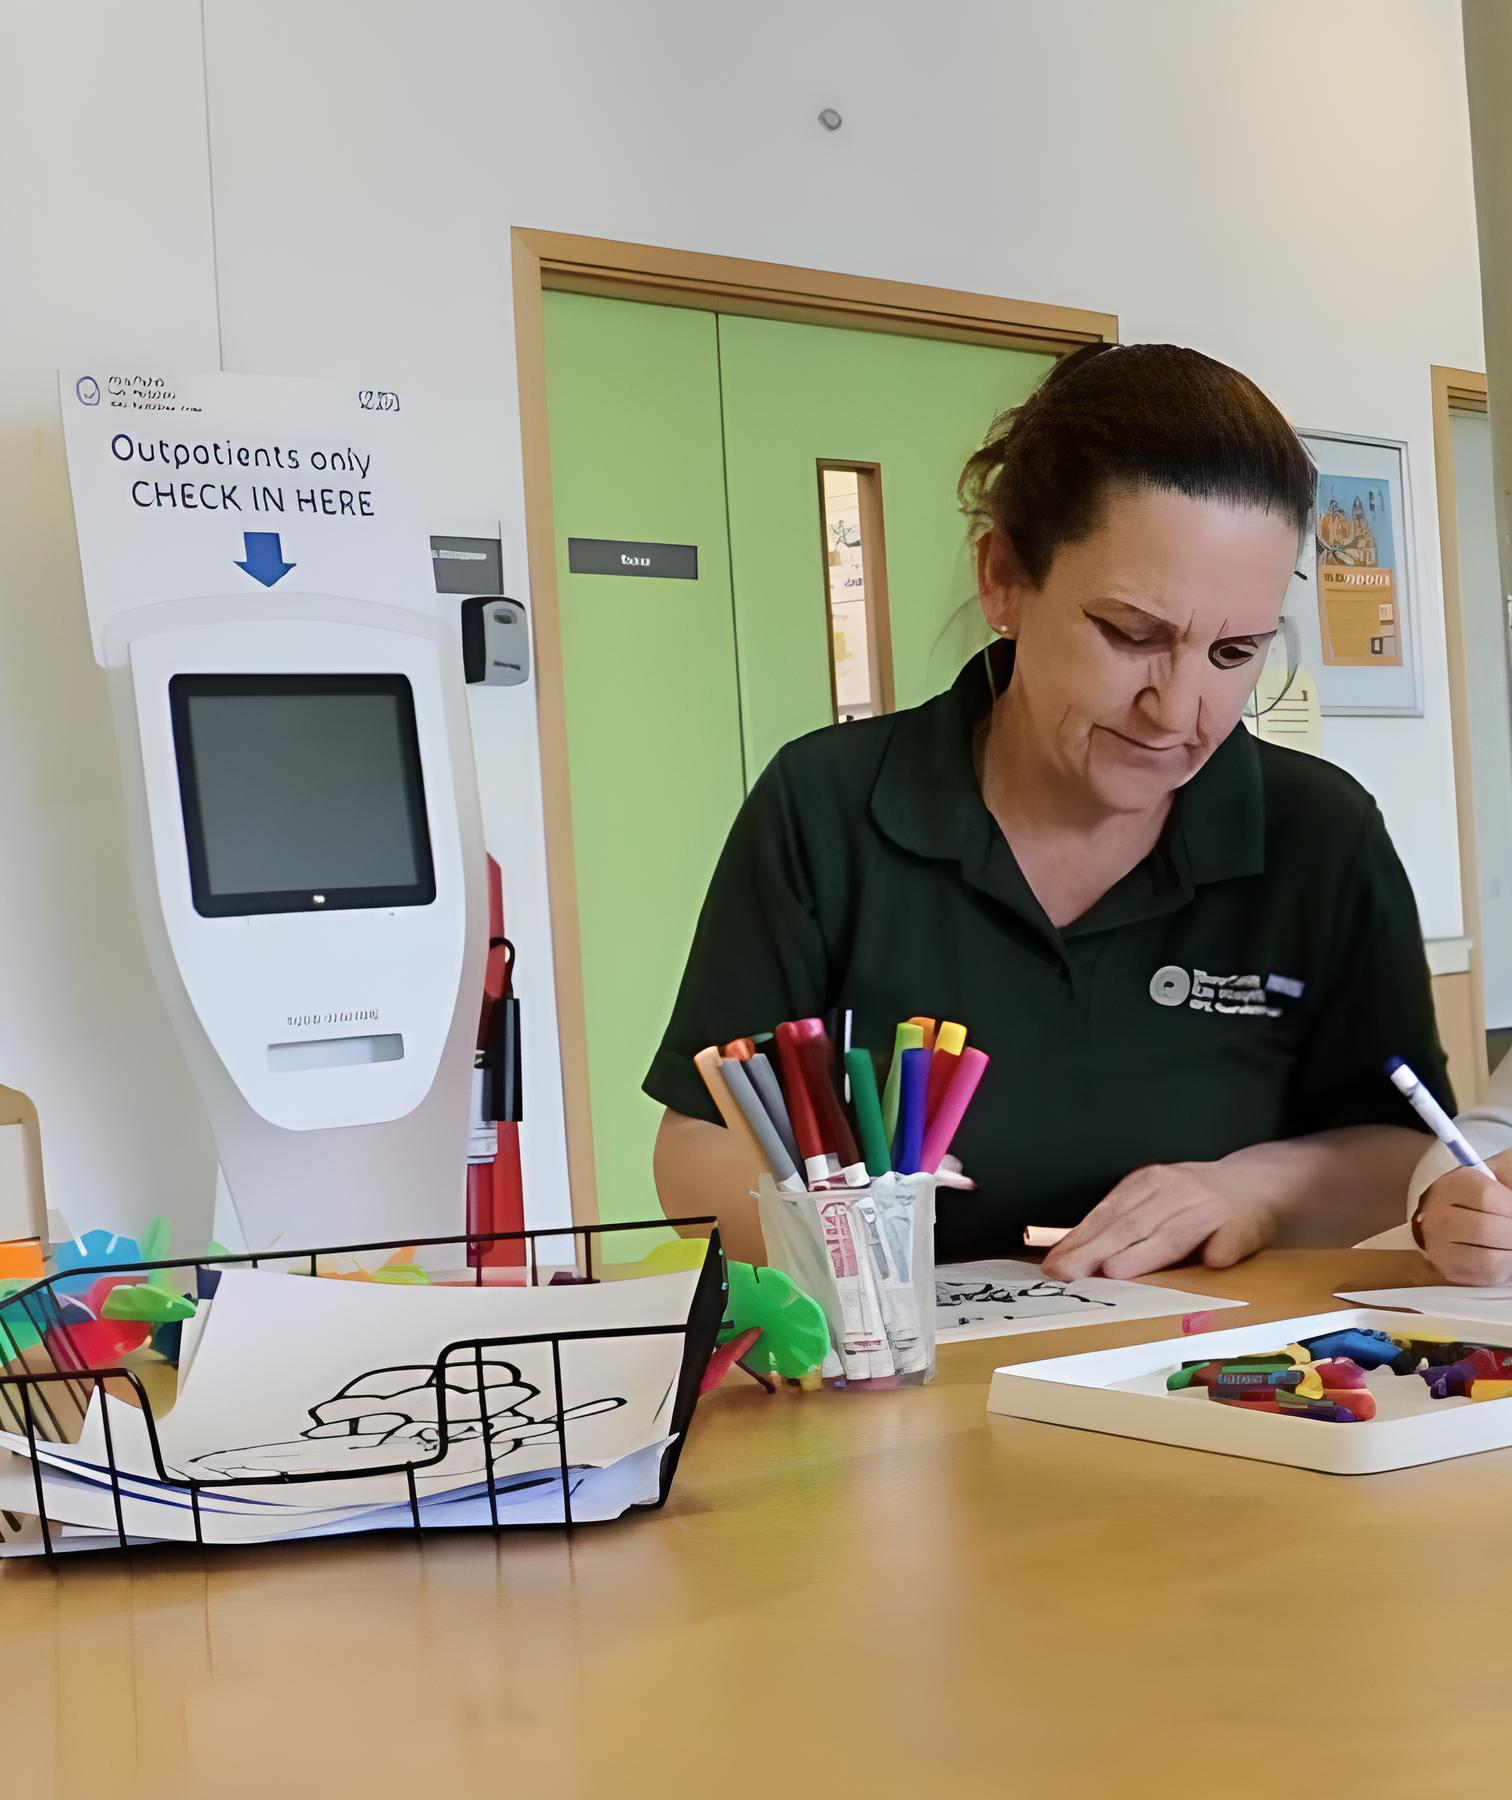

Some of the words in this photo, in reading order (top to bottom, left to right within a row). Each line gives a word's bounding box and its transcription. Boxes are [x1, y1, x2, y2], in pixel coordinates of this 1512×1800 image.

[111, 433, 300, 470] Outpatients
[310, 447, 371, 480] only
[131, 480, 243, 512] CHECK
[251, 486, 285, 513] IN
[295, 488, 375, 517] HERE
